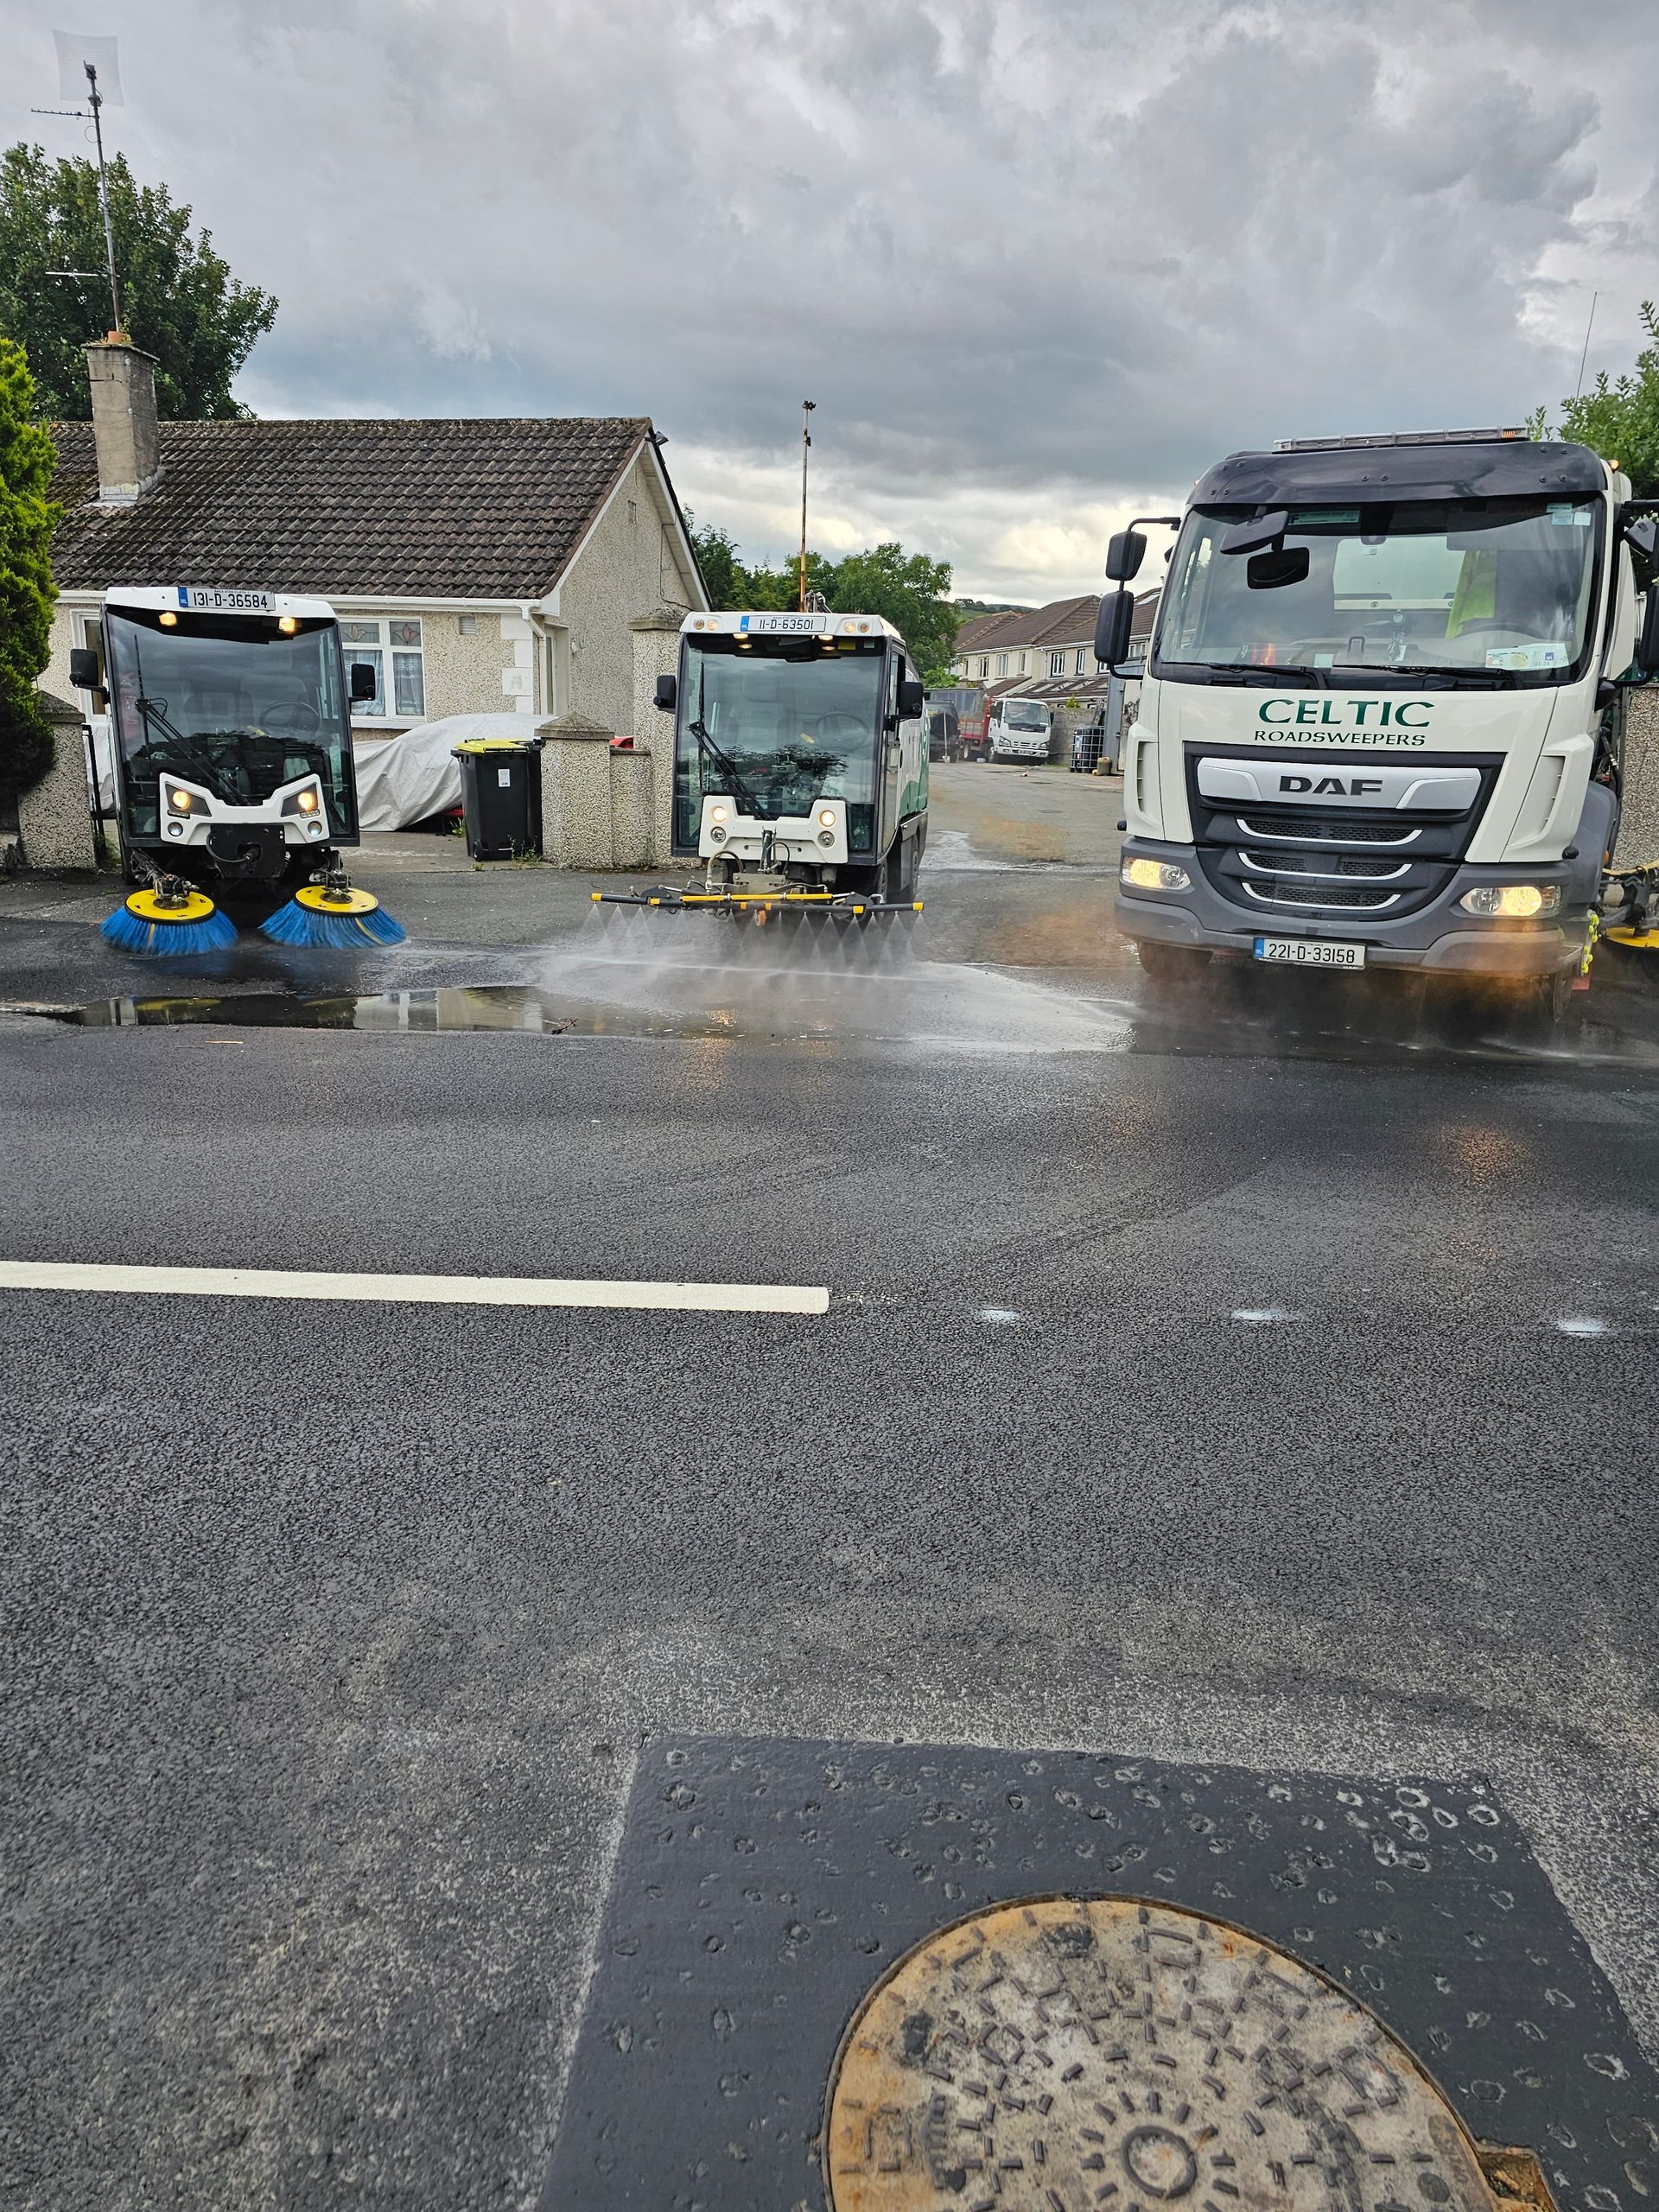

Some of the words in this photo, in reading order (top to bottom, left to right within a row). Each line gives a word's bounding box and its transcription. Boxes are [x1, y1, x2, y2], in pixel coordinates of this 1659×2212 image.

[194, 592, 268, 608] 131-D-36584
[760, 619, 814, 630] 11-D-63501
[1258, 698, 1435, 728] CELTIC
[1254, 730, 1426, 747] ROADSWEEPERS
[1279, 775, 1383, 797] DAF
[1268, 943, 1355, 964] 221-D-33158
